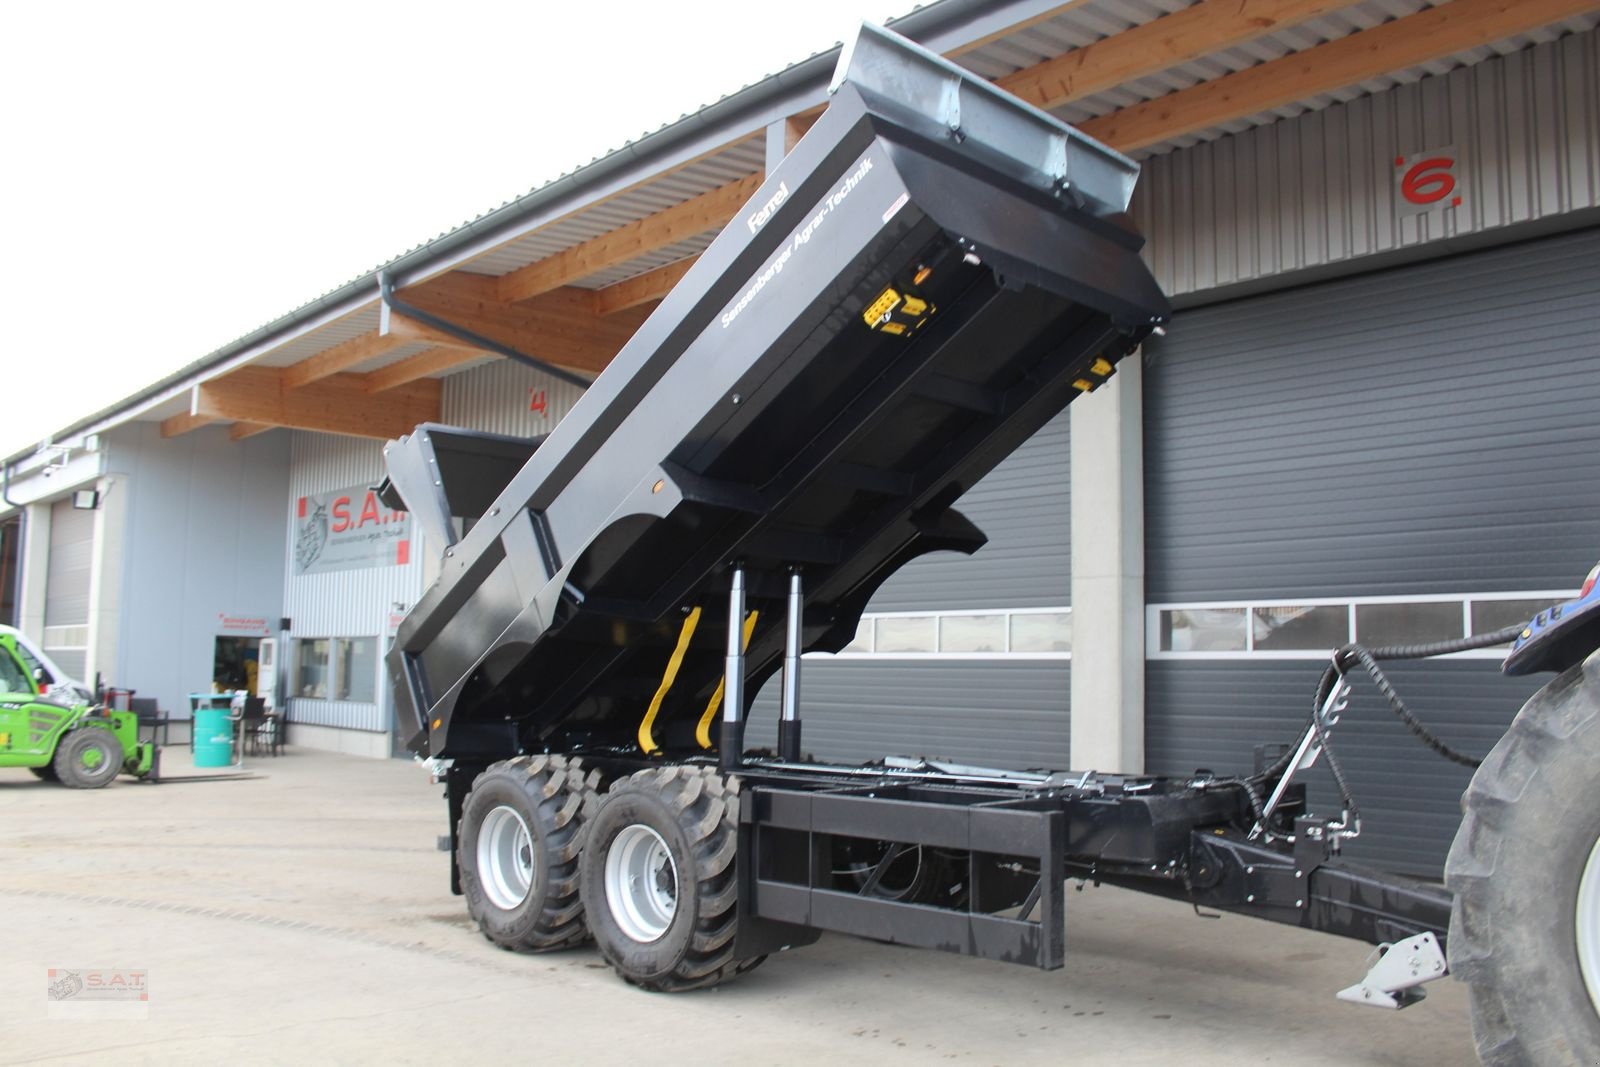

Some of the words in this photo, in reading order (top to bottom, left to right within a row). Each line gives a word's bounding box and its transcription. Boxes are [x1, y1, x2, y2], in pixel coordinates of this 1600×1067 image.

[1402, 158, 1455, 204] 6
[721, 245, 793, 329] Sensenberger
[794, 157, 874, 250] Agrar-Technik
[530, 391, 545, 414] 4
